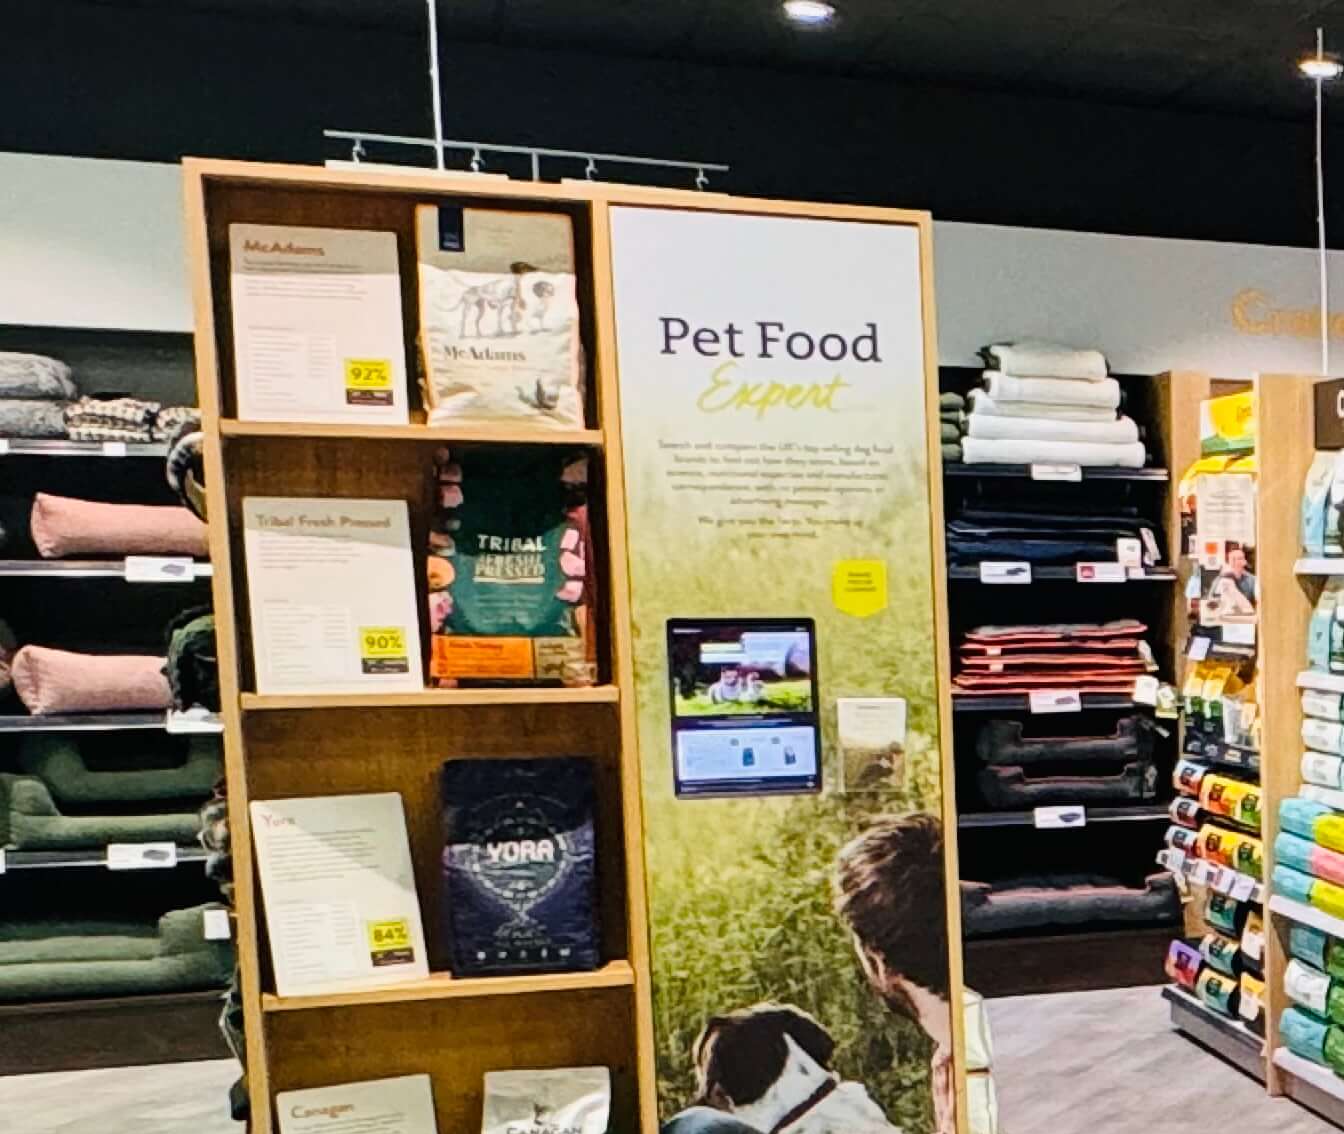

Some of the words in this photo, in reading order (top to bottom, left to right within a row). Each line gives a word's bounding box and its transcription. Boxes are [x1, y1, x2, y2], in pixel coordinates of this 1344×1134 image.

[658, 317, 745, 357] Pet
[755, 321, 882, 362] Food
[696, 359, 852, 420] Expert
[477, 534, 547, 551] TRIBAL
[487, 839, 554, 865] YORA
[291, 1103, 354, 1120] Canagan
